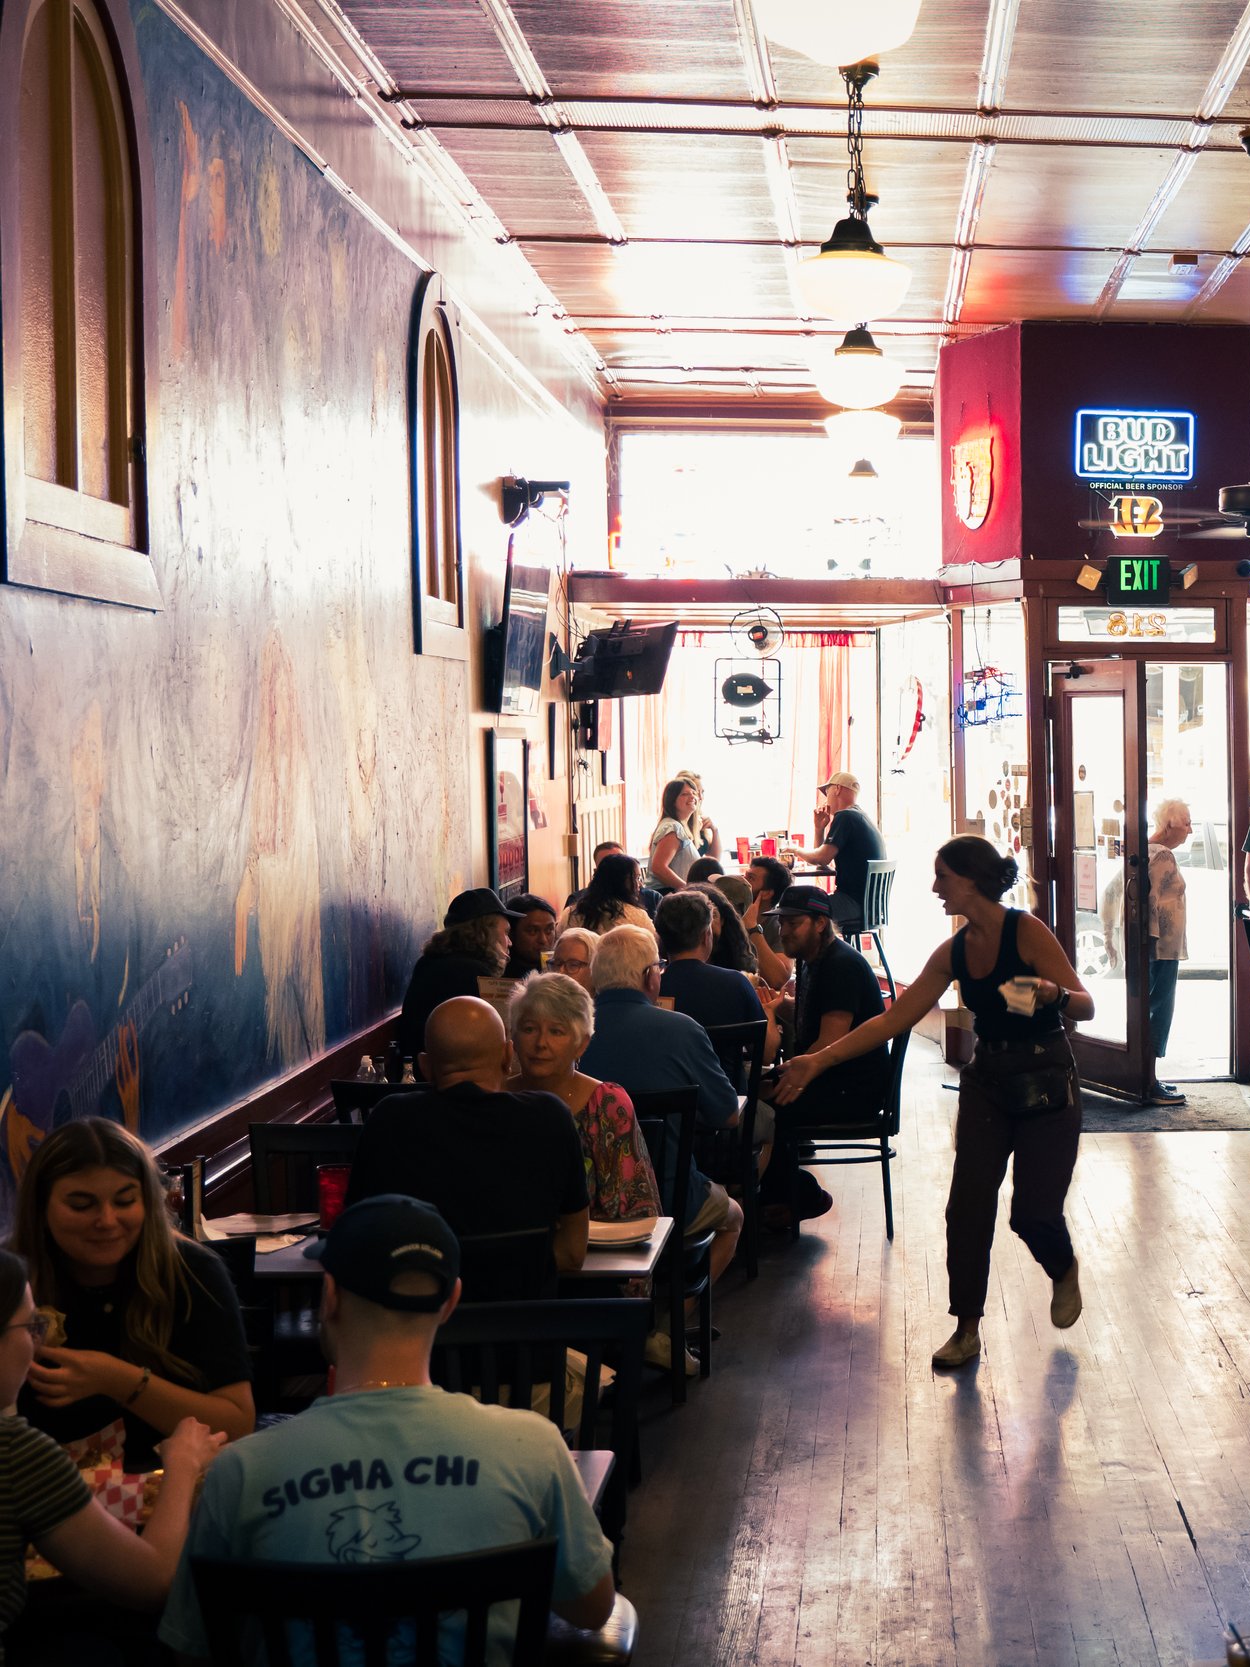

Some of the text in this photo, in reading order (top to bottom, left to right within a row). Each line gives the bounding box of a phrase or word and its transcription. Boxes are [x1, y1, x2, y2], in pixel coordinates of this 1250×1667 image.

[1098, 417, 1176, 444] BUD
[1082, 443, 1189, 473] LIGHT
[1089, 482, 1124, 490] OFFICIAL
[1125, 483, 1146, 491] BEER
[1120, 559, 1161, 591] EXIT
[262, 1455, 480, 1520] SIGMA CHI
